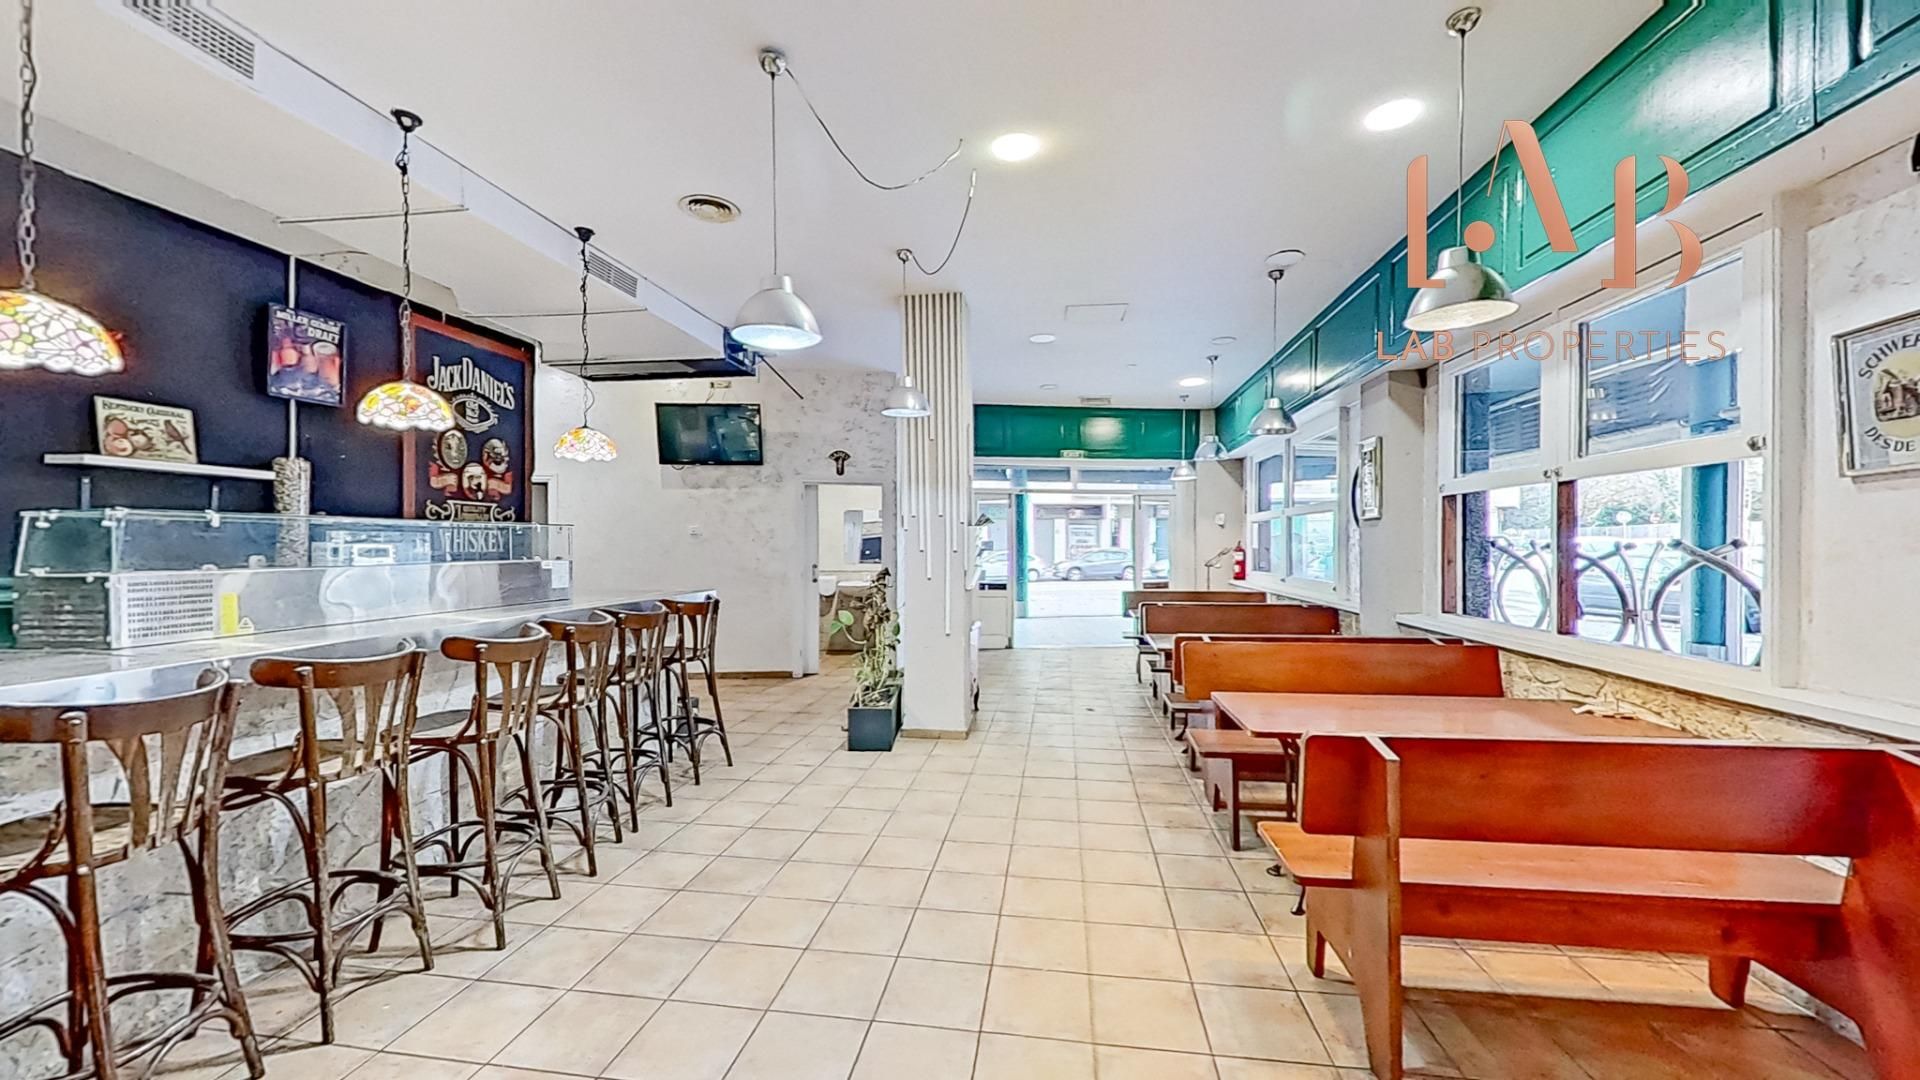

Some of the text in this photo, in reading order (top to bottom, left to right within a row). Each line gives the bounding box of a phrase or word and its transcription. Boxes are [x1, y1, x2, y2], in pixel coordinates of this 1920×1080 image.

[307, 326, 340, 344] DRAFT
[1864, 426, 1916, 452] DESDE
[439, 527, 507, 553] WHISKEY
